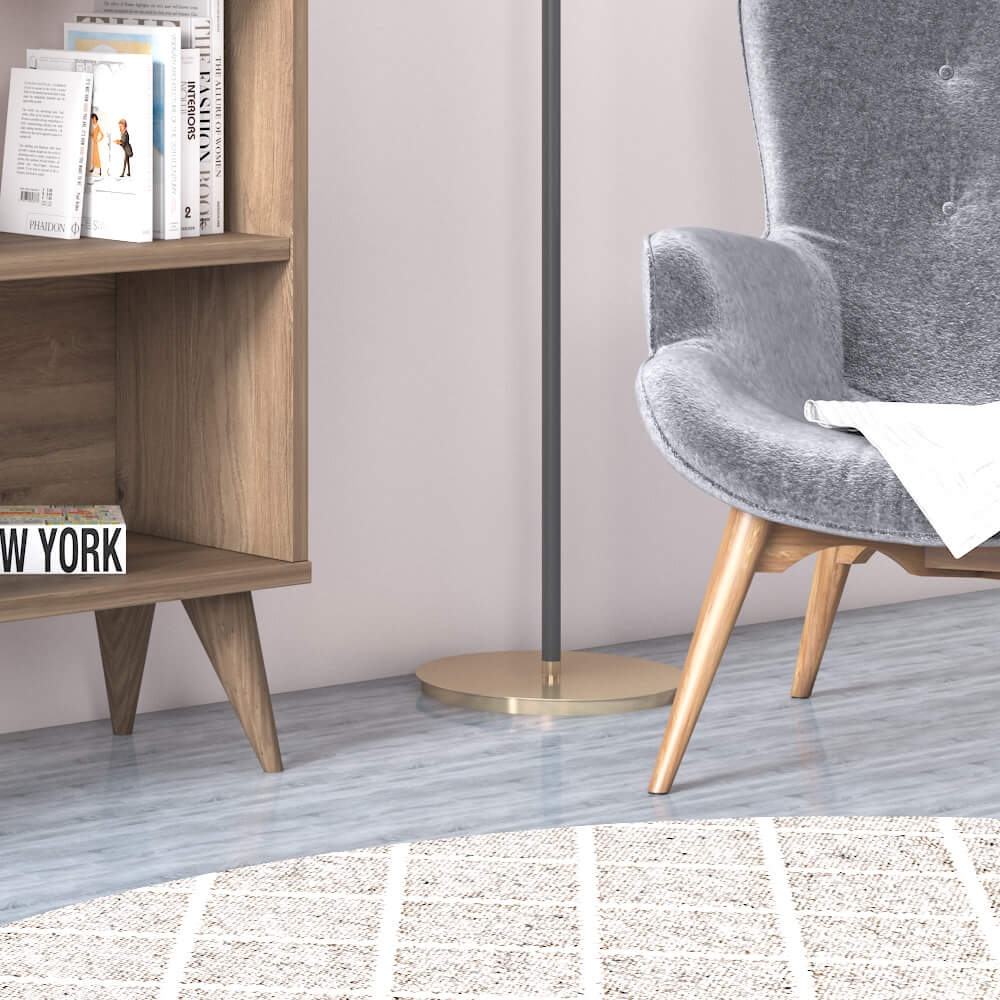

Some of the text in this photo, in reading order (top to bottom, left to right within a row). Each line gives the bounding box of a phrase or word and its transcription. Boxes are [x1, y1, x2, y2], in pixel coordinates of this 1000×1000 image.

[194, 20, 210, 64] THE
[187, 81, 196, 140] INTERIORS
[199, 71, 210, 162] FASHION
[215, 121, 222, 135] OF
[28, 220, 66, 233] PHAIDON
[184, 206, 191, 218] 2
[38, 526, 123, 573] YORK
